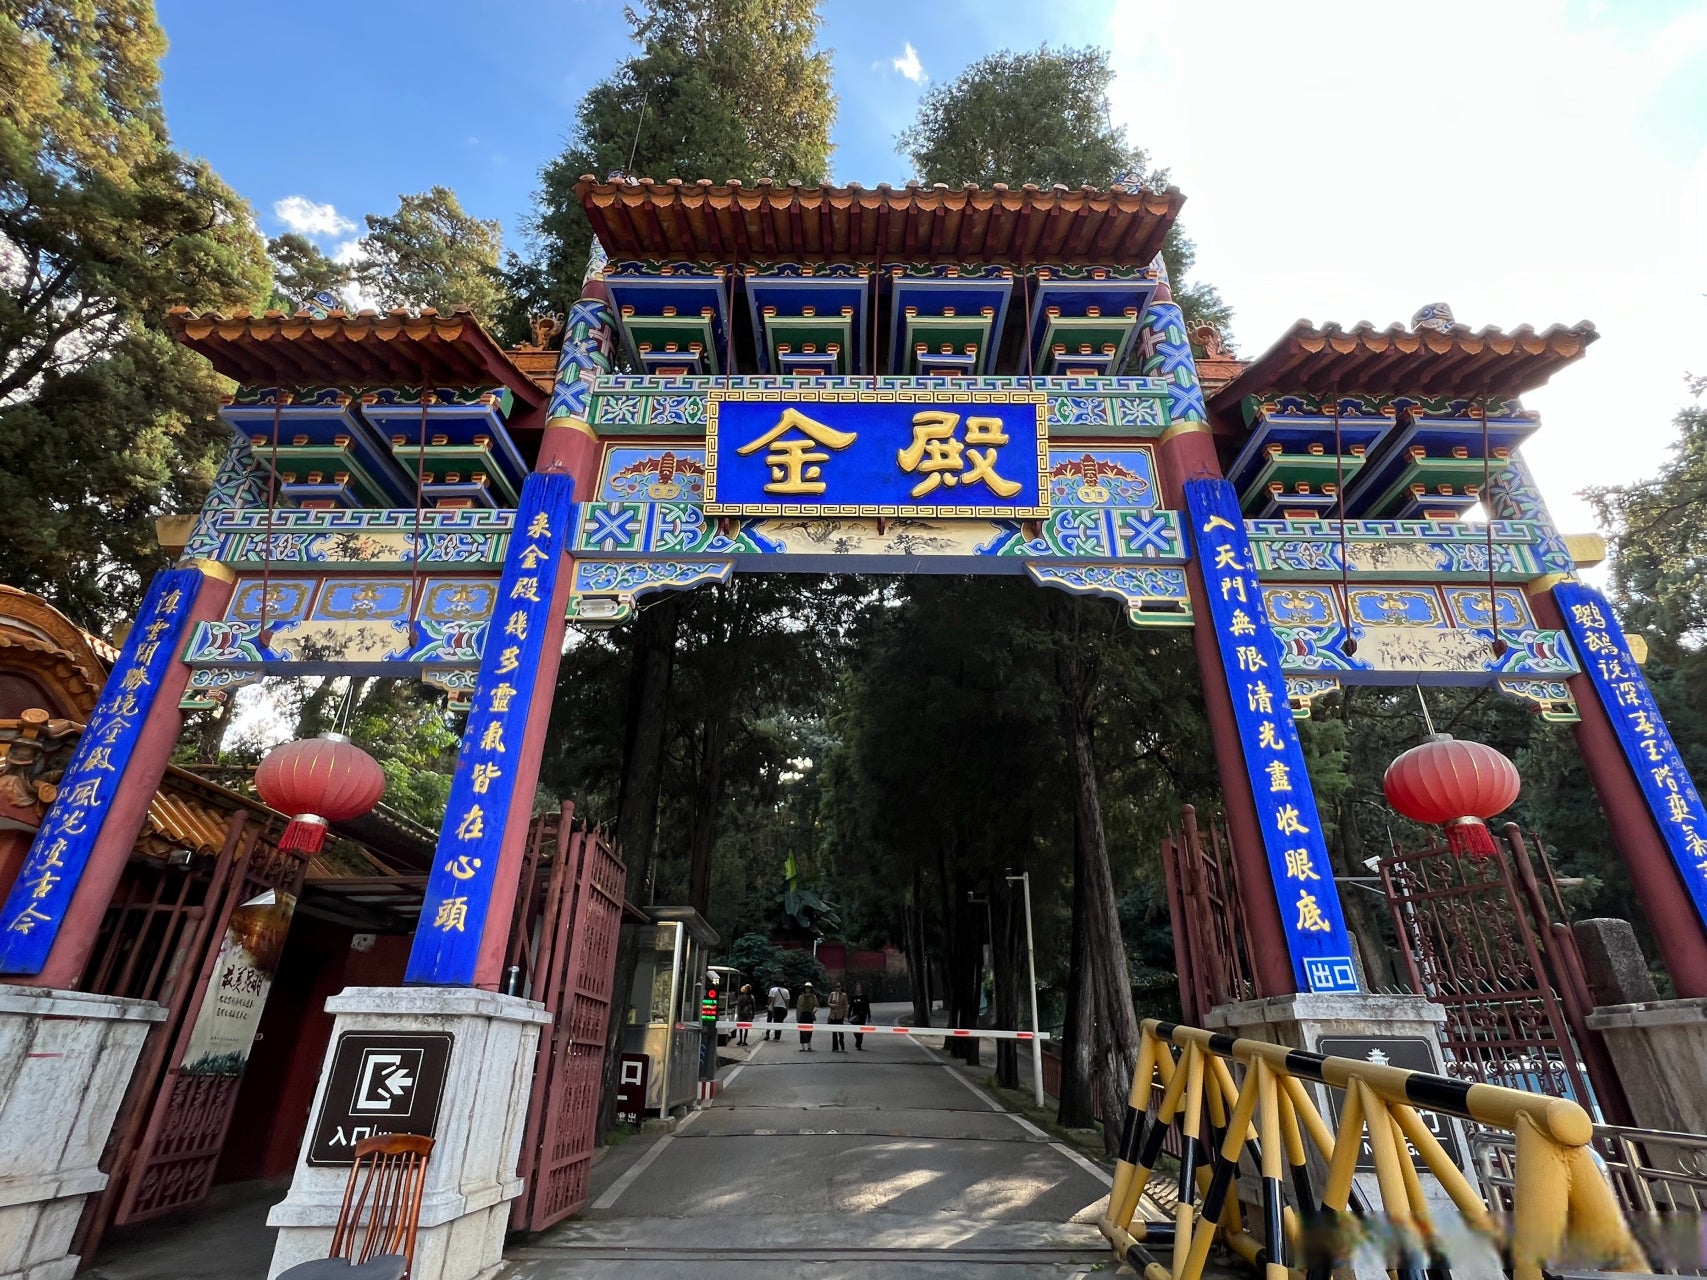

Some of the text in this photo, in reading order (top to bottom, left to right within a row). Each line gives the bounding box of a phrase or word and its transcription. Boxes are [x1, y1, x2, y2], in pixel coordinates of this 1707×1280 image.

[736, 407, 1023, 498] 金殿
[1312, 963, 1354, 987] 出口
[329, 1126, 371, 1147] 入口
